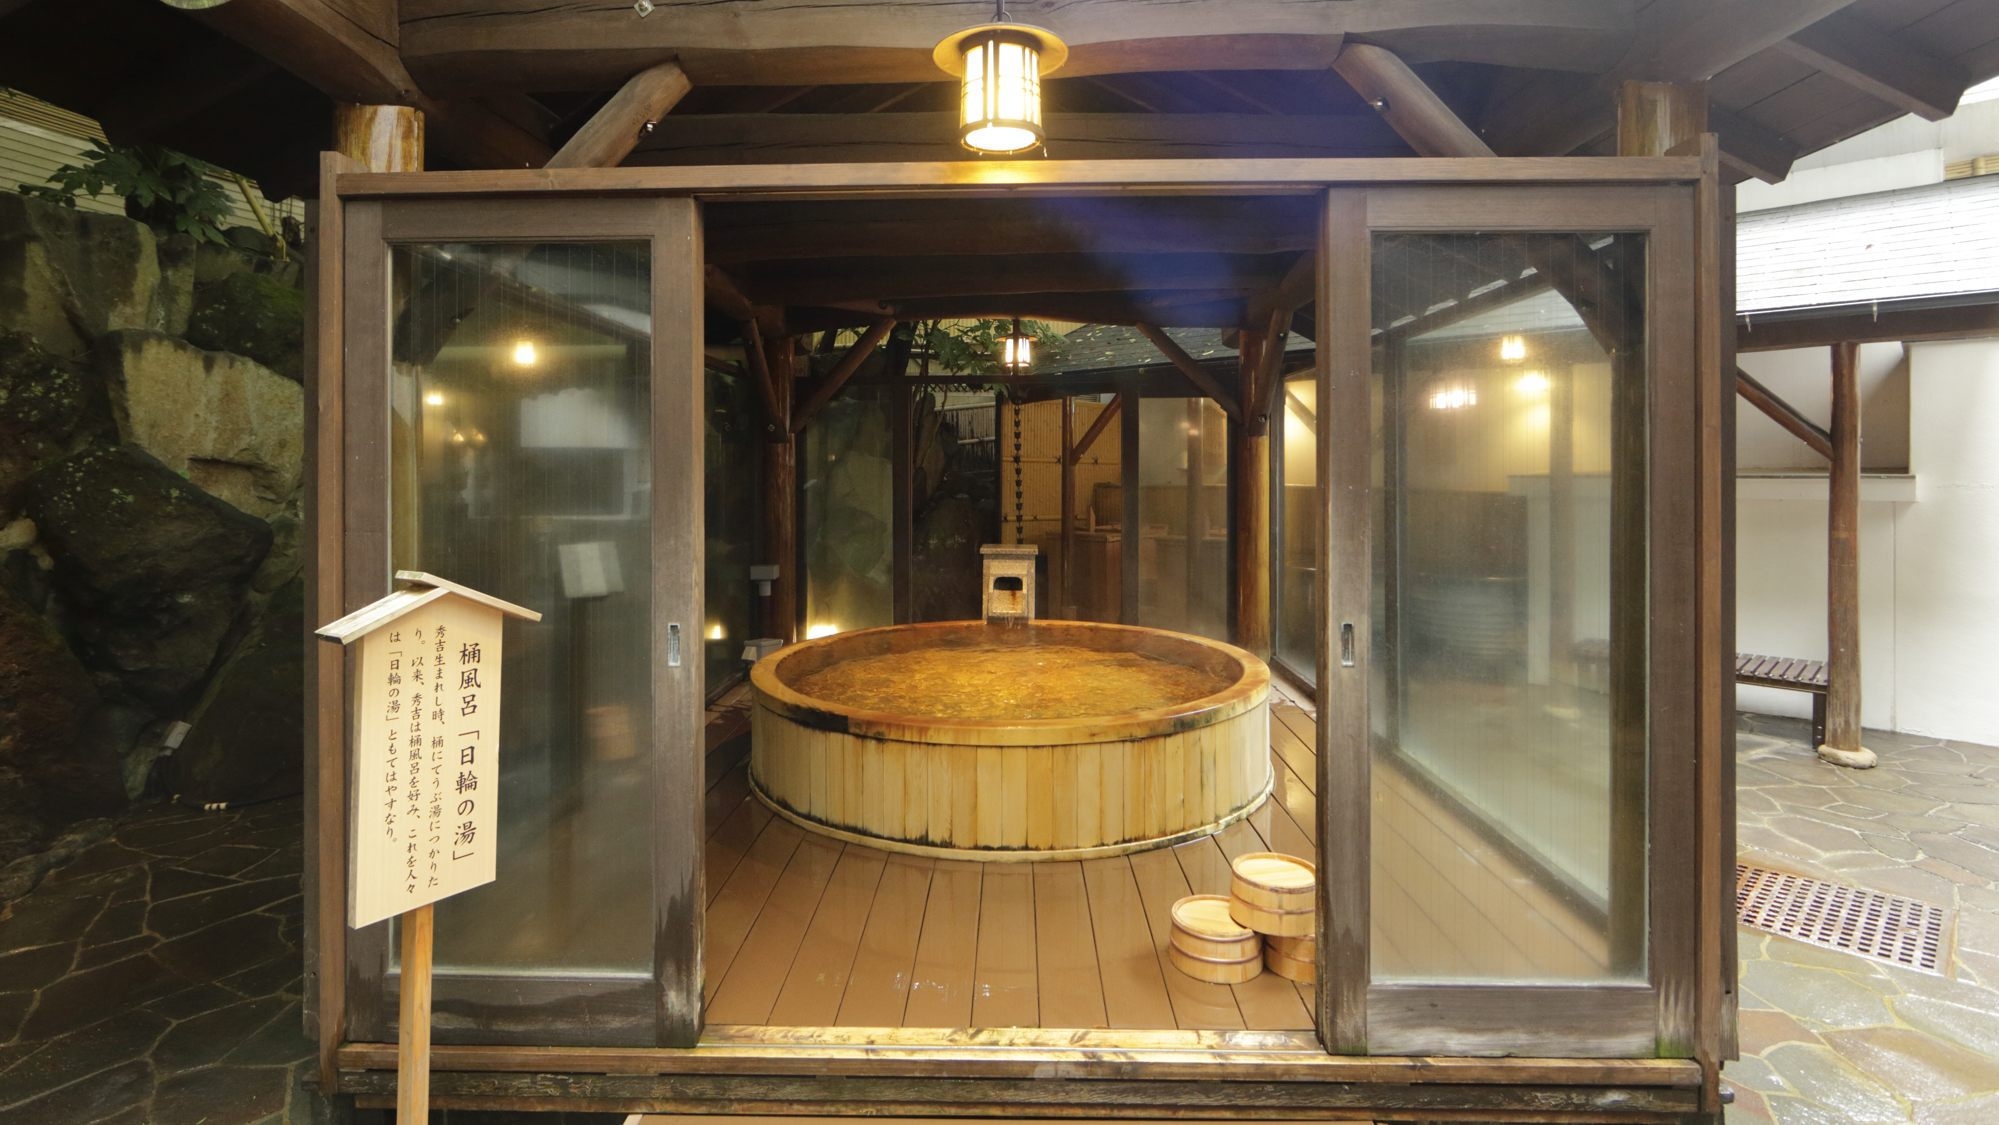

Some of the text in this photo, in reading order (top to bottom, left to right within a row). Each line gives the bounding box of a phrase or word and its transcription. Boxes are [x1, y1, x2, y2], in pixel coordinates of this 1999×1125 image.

[384, 631, 403, 843] は「日輪の湯」ともてはやすなり。
[405, 627, 425, 894] り。以来、秀吉は桶風呂を好み、これを人々
[428, 624, 447, 889] 秀吉生まれし時、桶にてうぶ湯につかりた
[452, 642, 481, 861] 桶風呂「日輪の湯」
